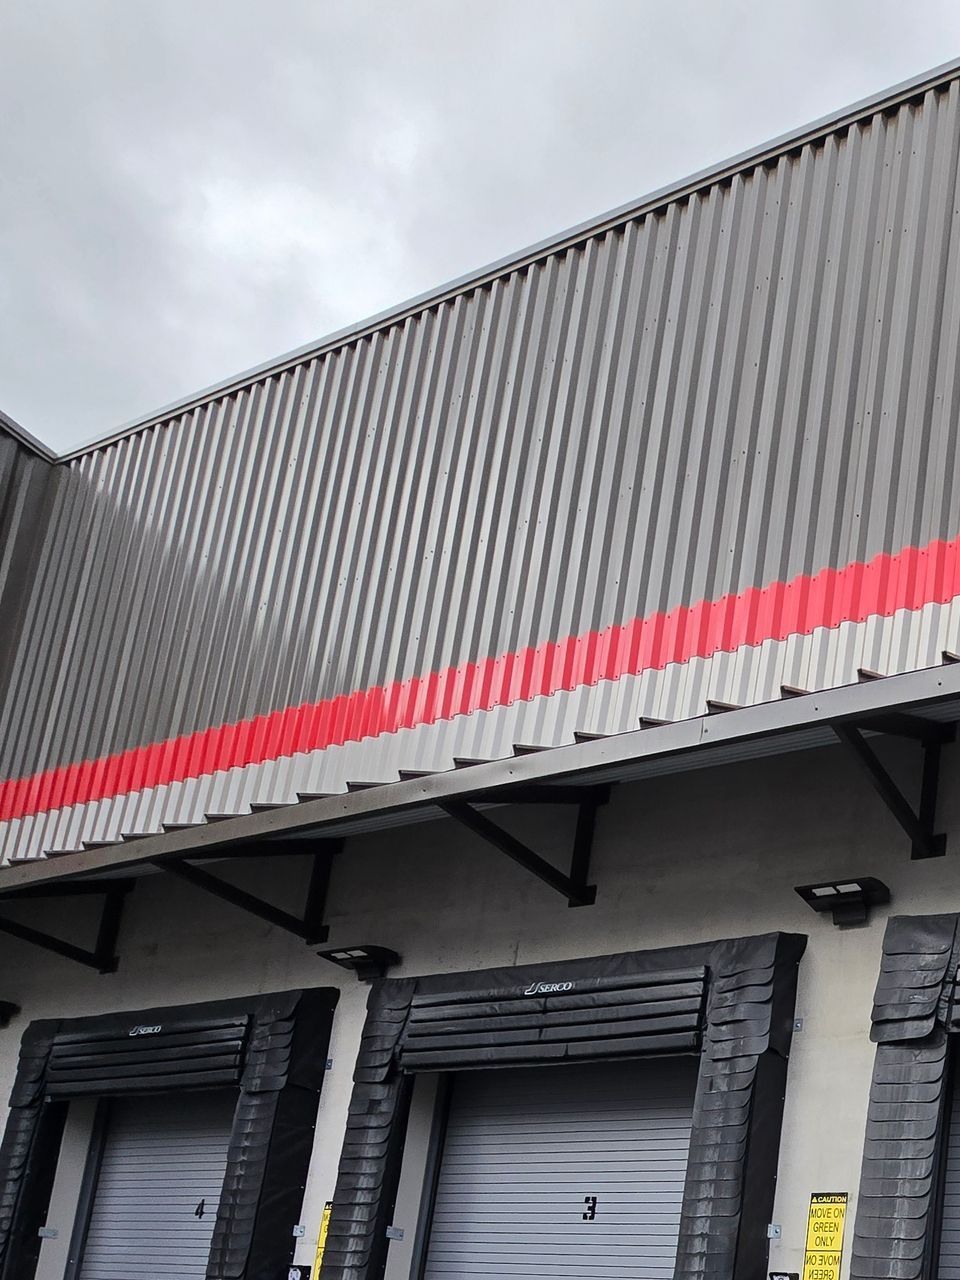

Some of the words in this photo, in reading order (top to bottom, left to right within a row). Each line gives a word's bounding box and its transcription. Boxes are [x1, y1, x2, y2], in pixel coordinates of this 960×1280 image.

[538, 981, 572, 993] SERCO
[195, 1199, 205, 1219] 4
[583, 1196, 597, 1220] 3
[811, 1208, 832, 1219] MOVE
[833, 1208, 845, 1218] ON
[813, 1222, 839, 1232] GREEN
[815, 1236, 835, 1247] ONLY
